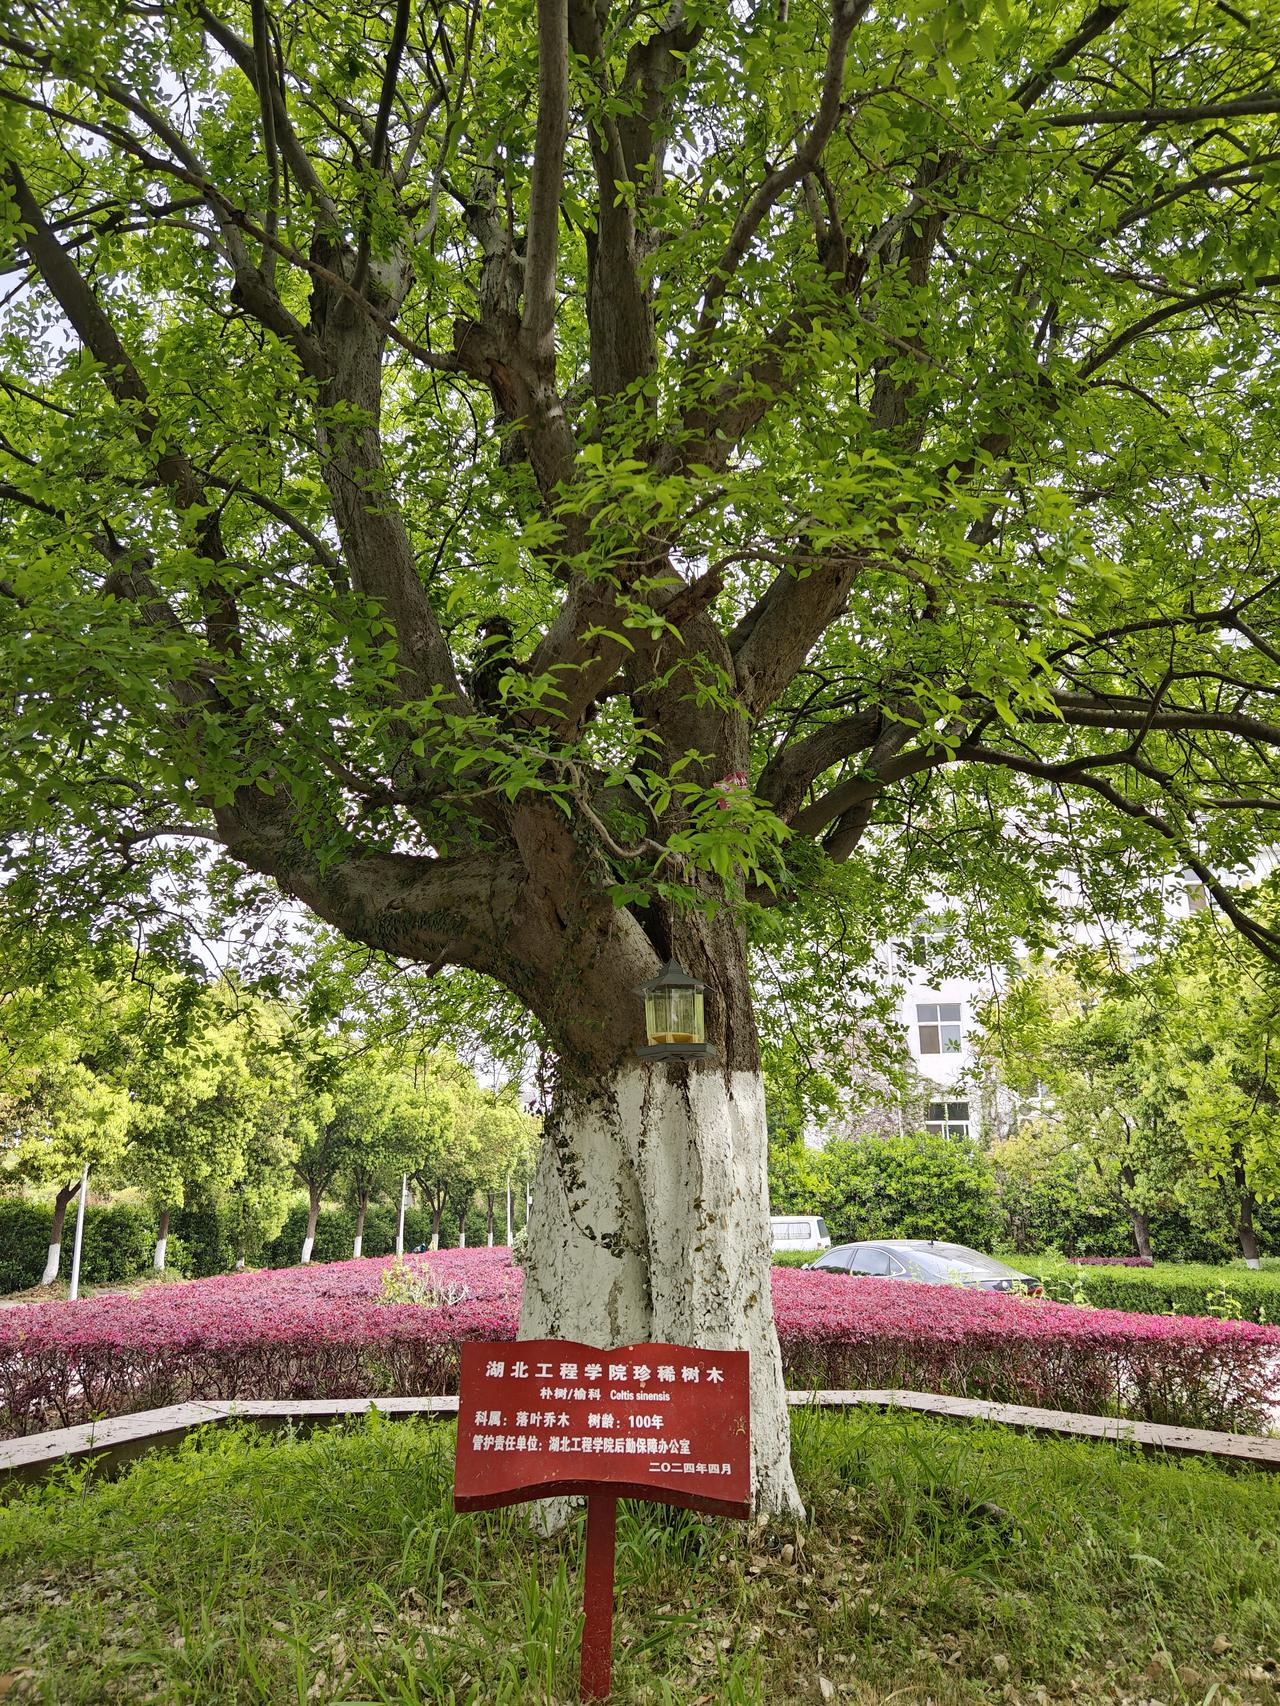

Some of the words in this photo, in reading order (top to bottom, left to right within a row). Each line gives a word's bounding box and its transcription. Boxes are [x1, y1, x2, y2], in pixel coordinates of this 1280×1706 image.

[485, 1360, 725, 1384] 湖北工程学院珍稀树木
[539, 1387, 602, 1401] 朴树/榆科
[609, 1389, 635, 1401] Celtis
[635, 1391, 671, 1402] sinensis
